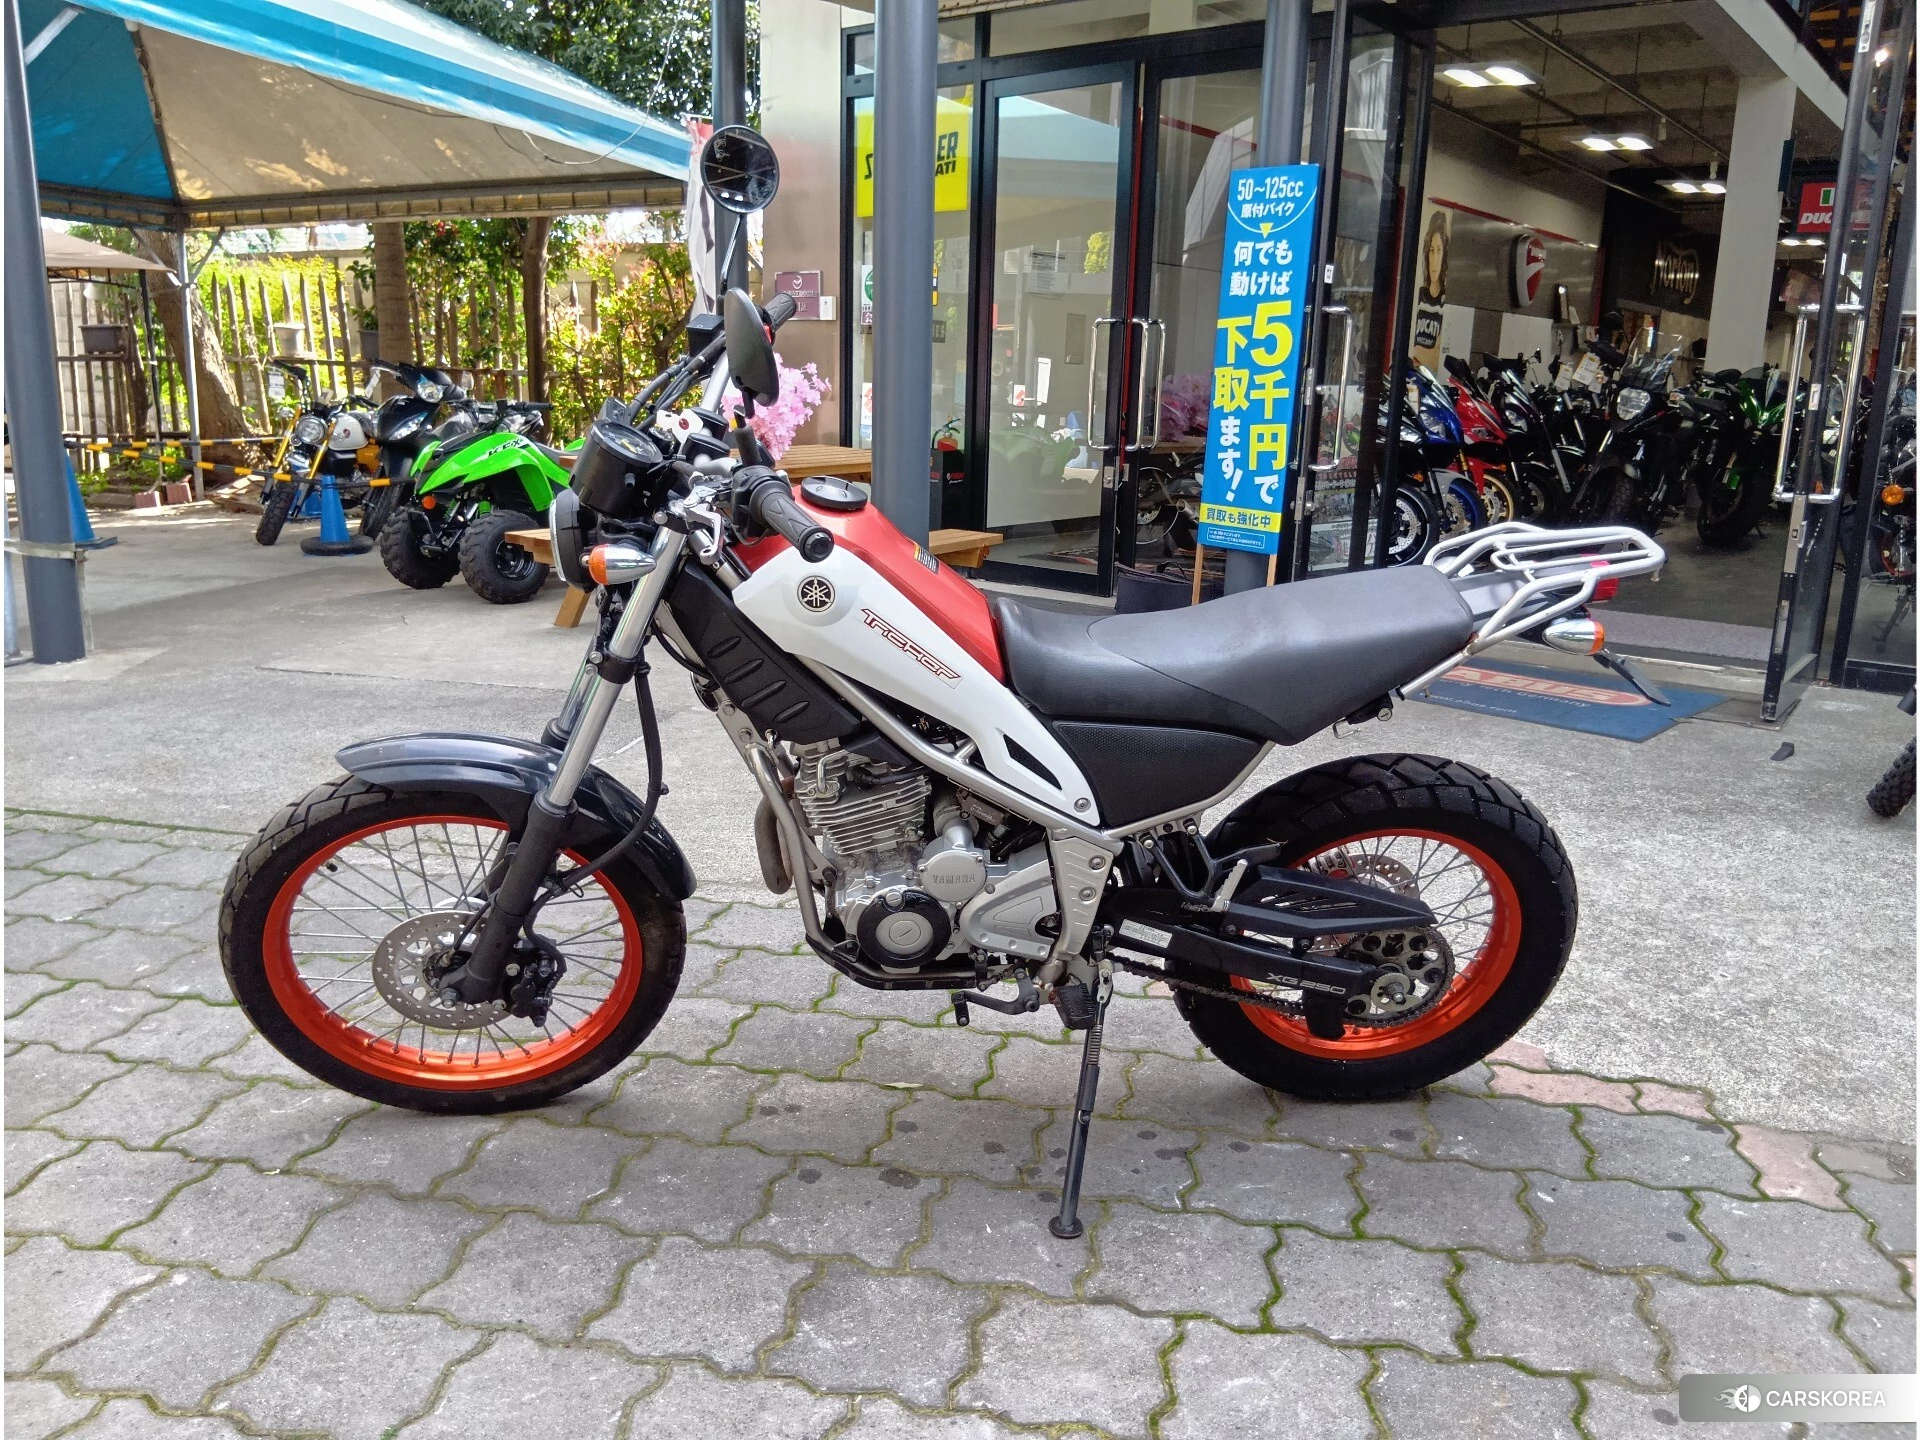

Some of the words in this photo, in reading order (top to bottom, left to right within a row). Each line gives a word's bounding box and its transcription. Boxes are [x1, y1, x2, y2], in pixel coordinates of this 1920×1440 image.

[1241, 201, 1295, 219] 原付バイク
[1800, 212, 1833, 225] DUC
[1233, 239, 1293, 267] 何でも
[1229, 270, 1293, 297] 動けば
[1206, 507, 1271, 529] 買取も強化中
[1447, 669, 1618, 701] ABUS
[932, 873, 976, 884] YAMAHA
[1266, 972, 1299, 985] XG
[1299, 980, 1347, 995] 250
